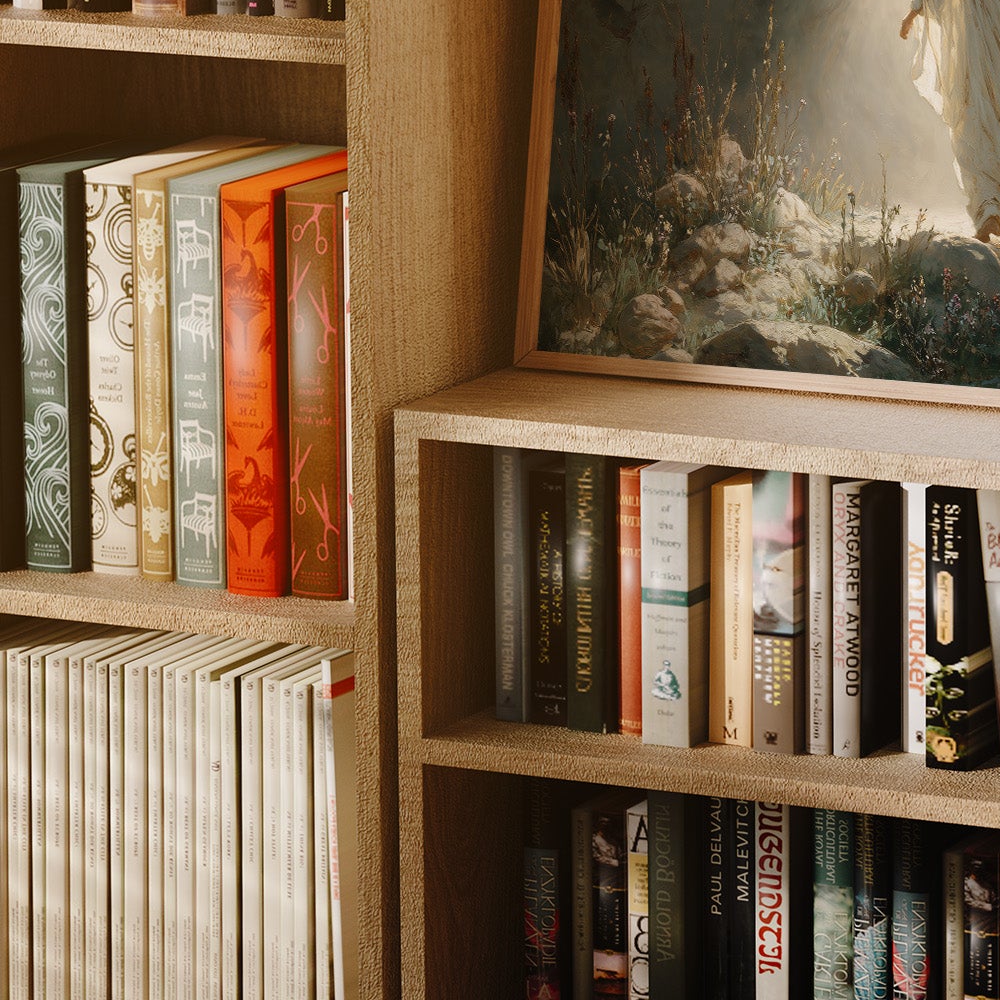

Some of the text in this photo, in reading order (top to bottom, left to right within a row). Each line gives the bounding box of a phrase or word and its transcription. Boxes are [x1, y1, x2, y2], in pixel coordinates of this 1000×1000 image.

[502, 455, 512, 690] DOWNTOWN OWL CHUCK KLOSTERMAN
[834, 492, 846, 669] ORYX AND CRAKE
[846, 493, 860, 697] MARGARET ATWOOD
[710, 798, 722, 915] PAUL DELVAU
